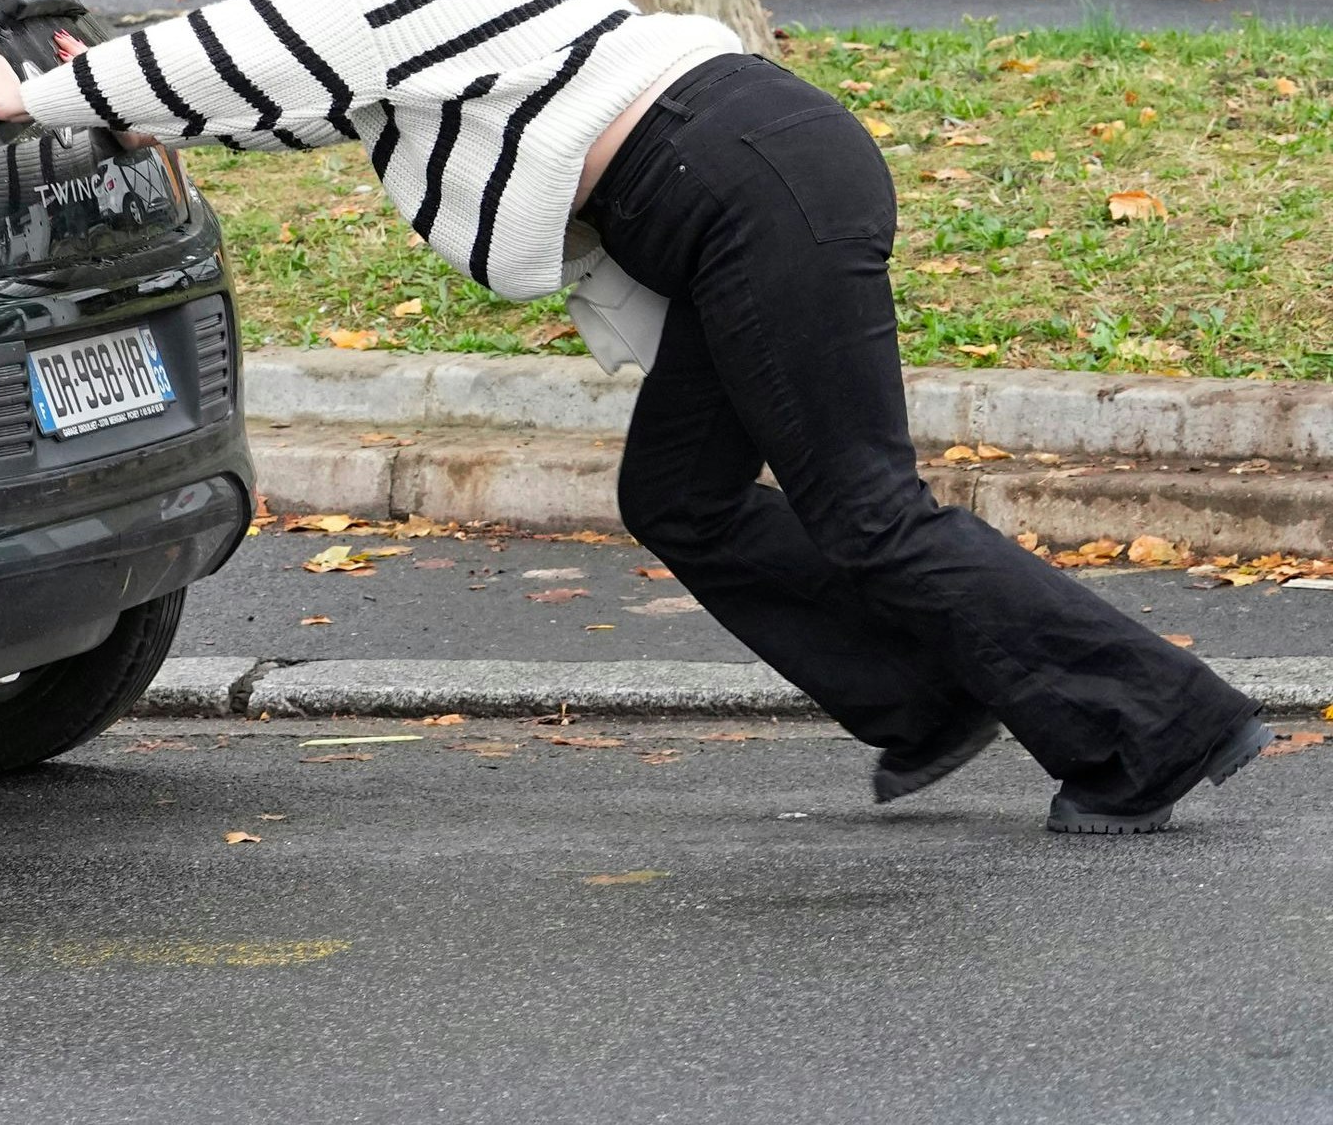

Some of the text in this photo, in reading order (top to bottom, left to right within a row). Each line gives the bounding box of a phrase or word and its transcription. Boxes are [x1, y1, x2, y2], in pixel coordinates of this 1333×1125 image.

[34, 173, 111, 208] TWING
[153, 364, 172, 394] 33
[39, 402, 47, 420] F
